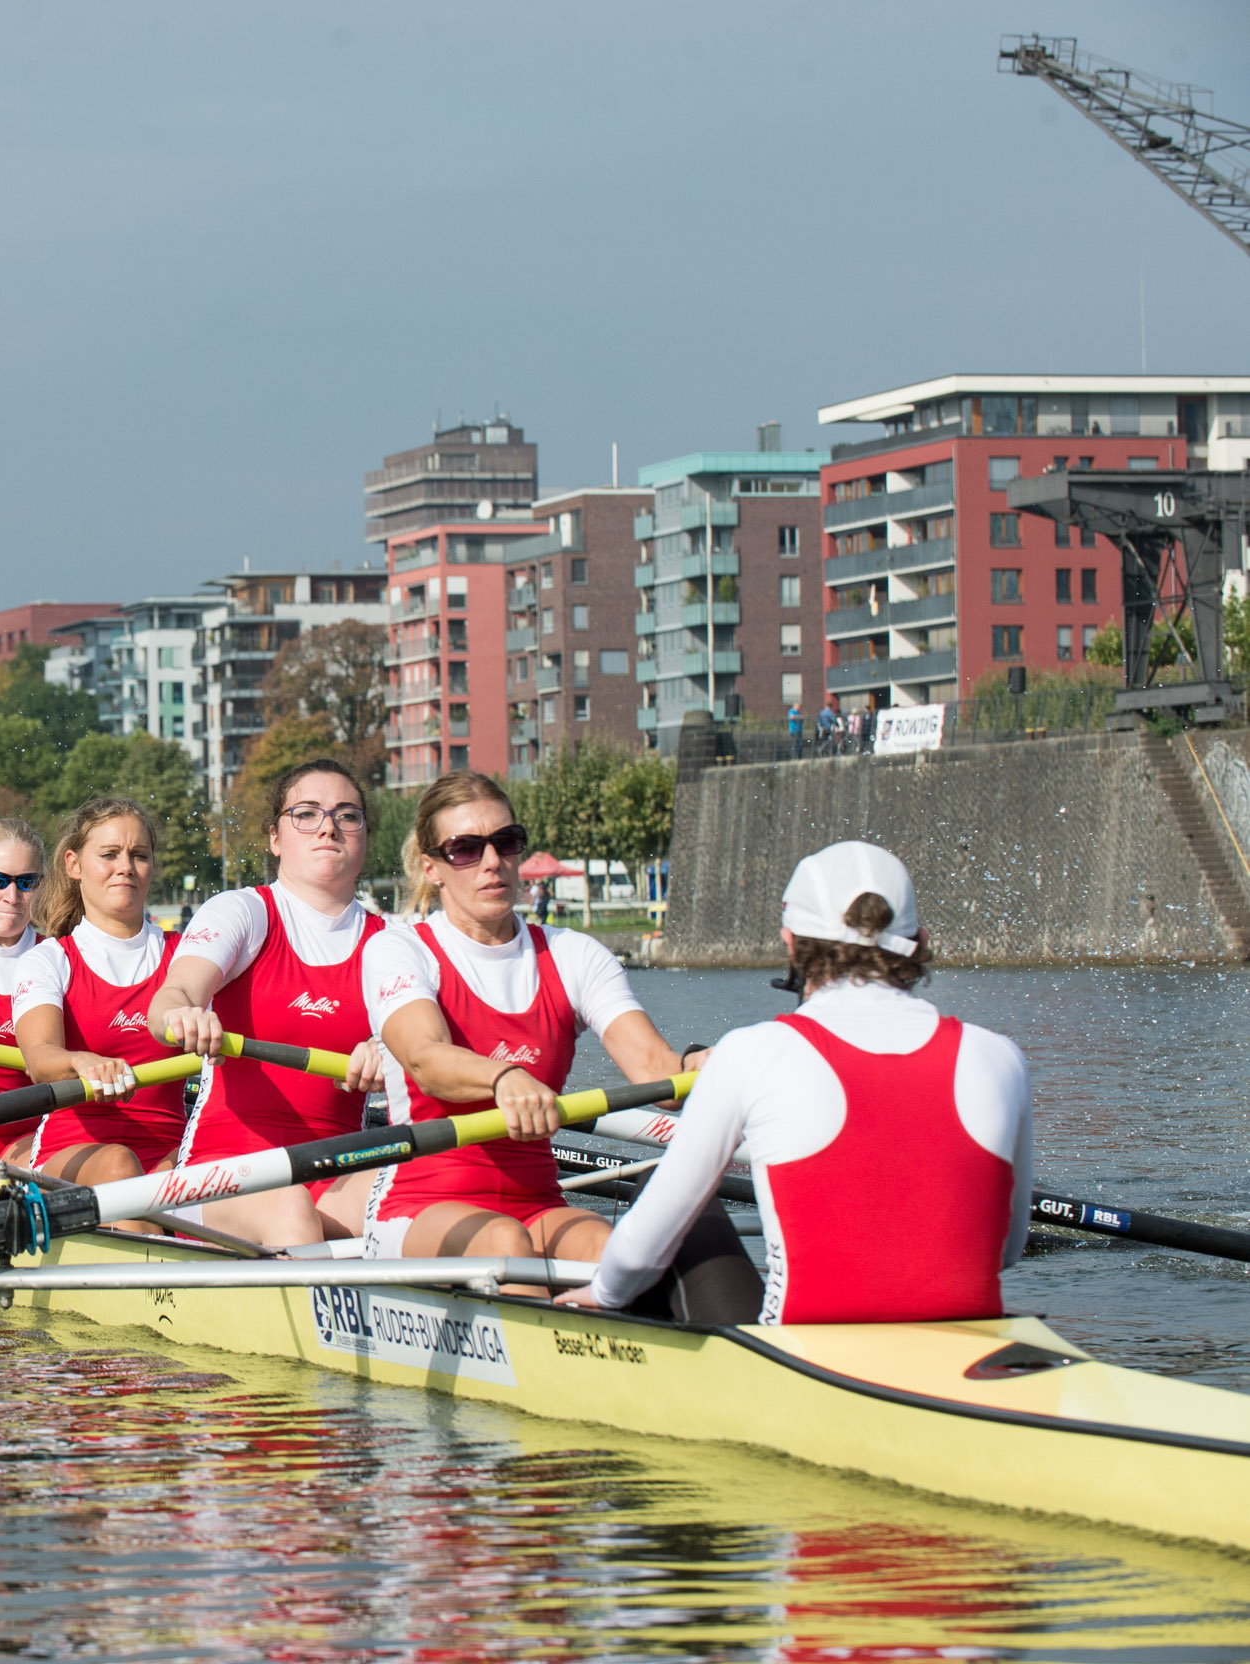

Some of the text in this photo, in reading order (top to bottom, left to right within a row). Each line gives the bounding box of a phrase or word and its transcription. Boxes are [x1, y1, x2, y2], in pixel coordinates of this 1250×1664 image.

[1153, 491, 1176, 517] 10
[894, 715, 938, 737] ROWING
[288, 991, 337, 1015] Melitta
[108, 1009, 148, 1028] Melitta
[489, 1041, 538, 1065] Melitta
[551, 1147, 594, 1166] HNELL.
[148, 1165, 246, 1212] Melitta
[1040, 1199, 1121, 1225] GUT. RBL
[329, 1286, 373, 1338] RBL
[372, 1304, 508, 1365] RUDER-BUNDESLIGA
